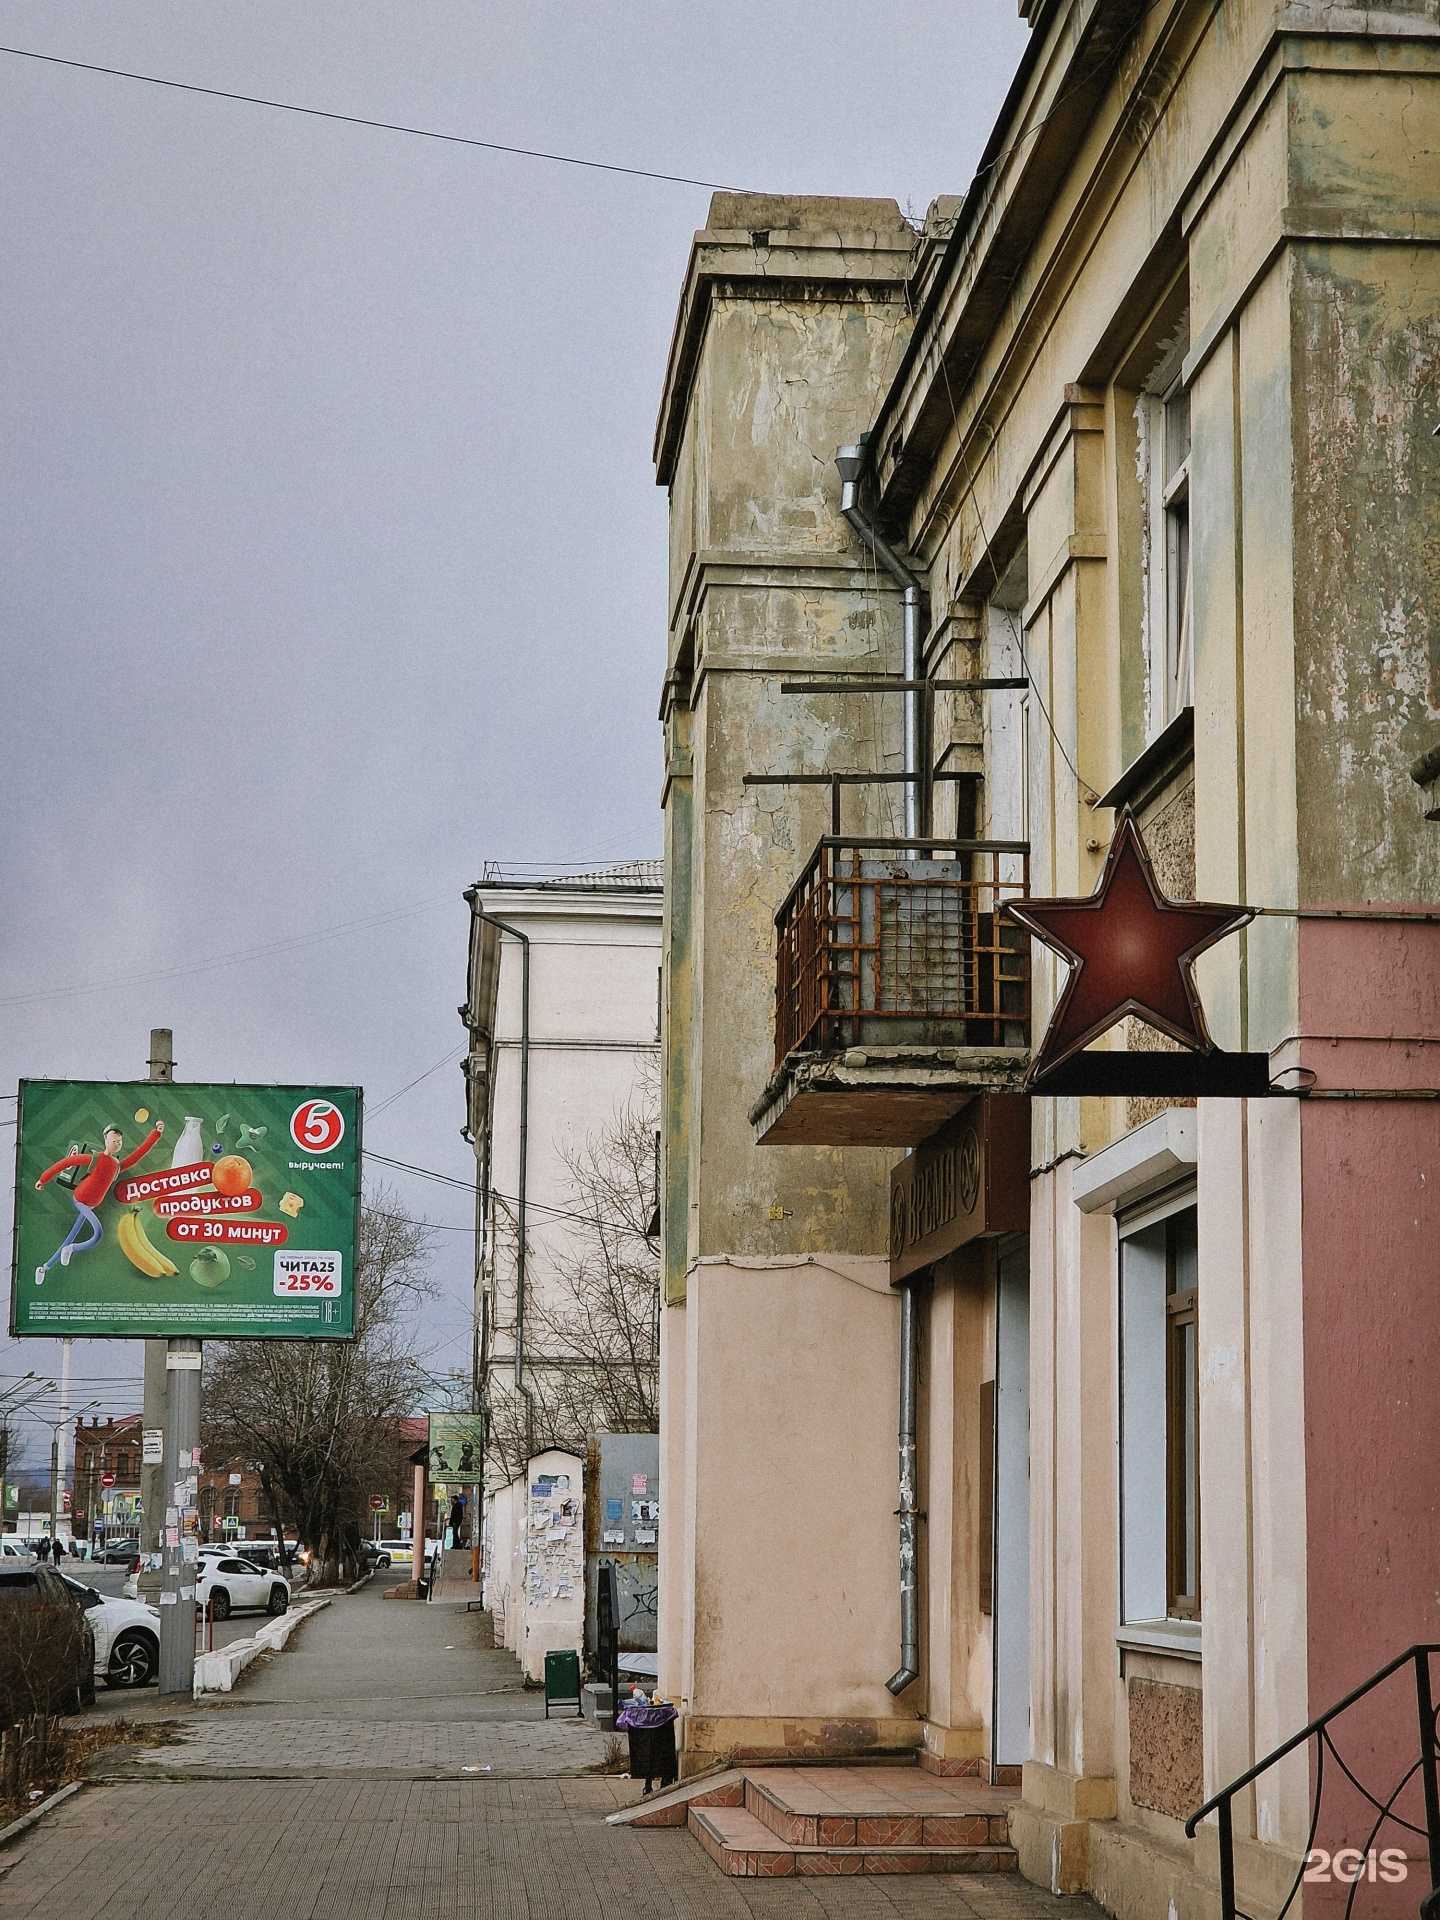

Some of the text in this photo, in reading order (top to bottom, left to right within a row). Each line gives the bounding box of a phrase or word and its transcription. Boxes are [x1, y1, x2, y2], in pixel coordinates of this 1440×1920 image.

[304, 1105, 335, 1144] 5
[288, 1161, 345, 1171] выручает!
[126, 1167, 211, 1201] Доставка
[160, 1195, 252, 1216] продуктов
[177, 1223, 281, 1242] от 30 минут
[280, 1261, 335, 1273] ЧИТА25
[279, 1275, 334, 1291] -25%
